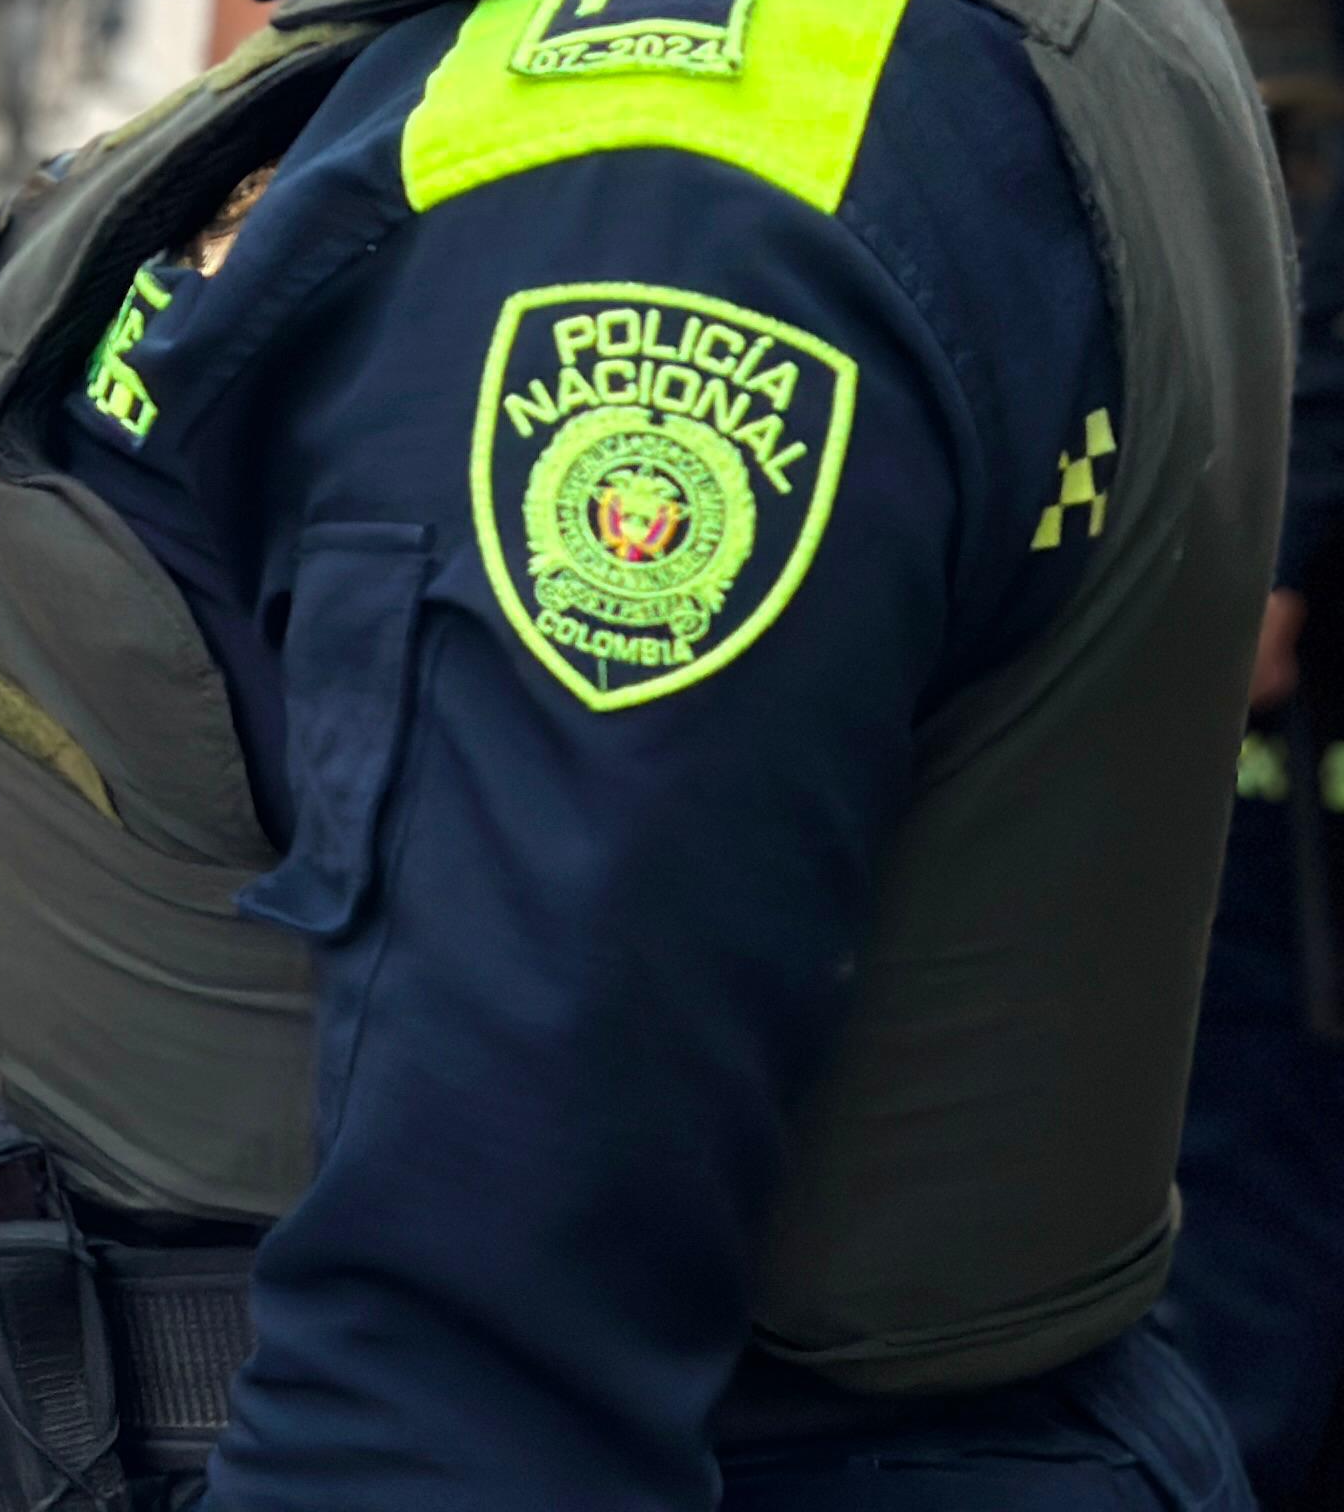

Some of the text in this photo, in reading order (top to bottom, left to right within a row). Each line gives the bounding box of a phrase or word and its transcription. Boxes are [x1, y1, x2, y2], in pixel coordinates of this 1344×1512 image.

[553, 308, 799, 412] POLICÍA
[503, 358, 808, 495] NACIONAL
[535, 607, 695, 667] COLOMBIA
